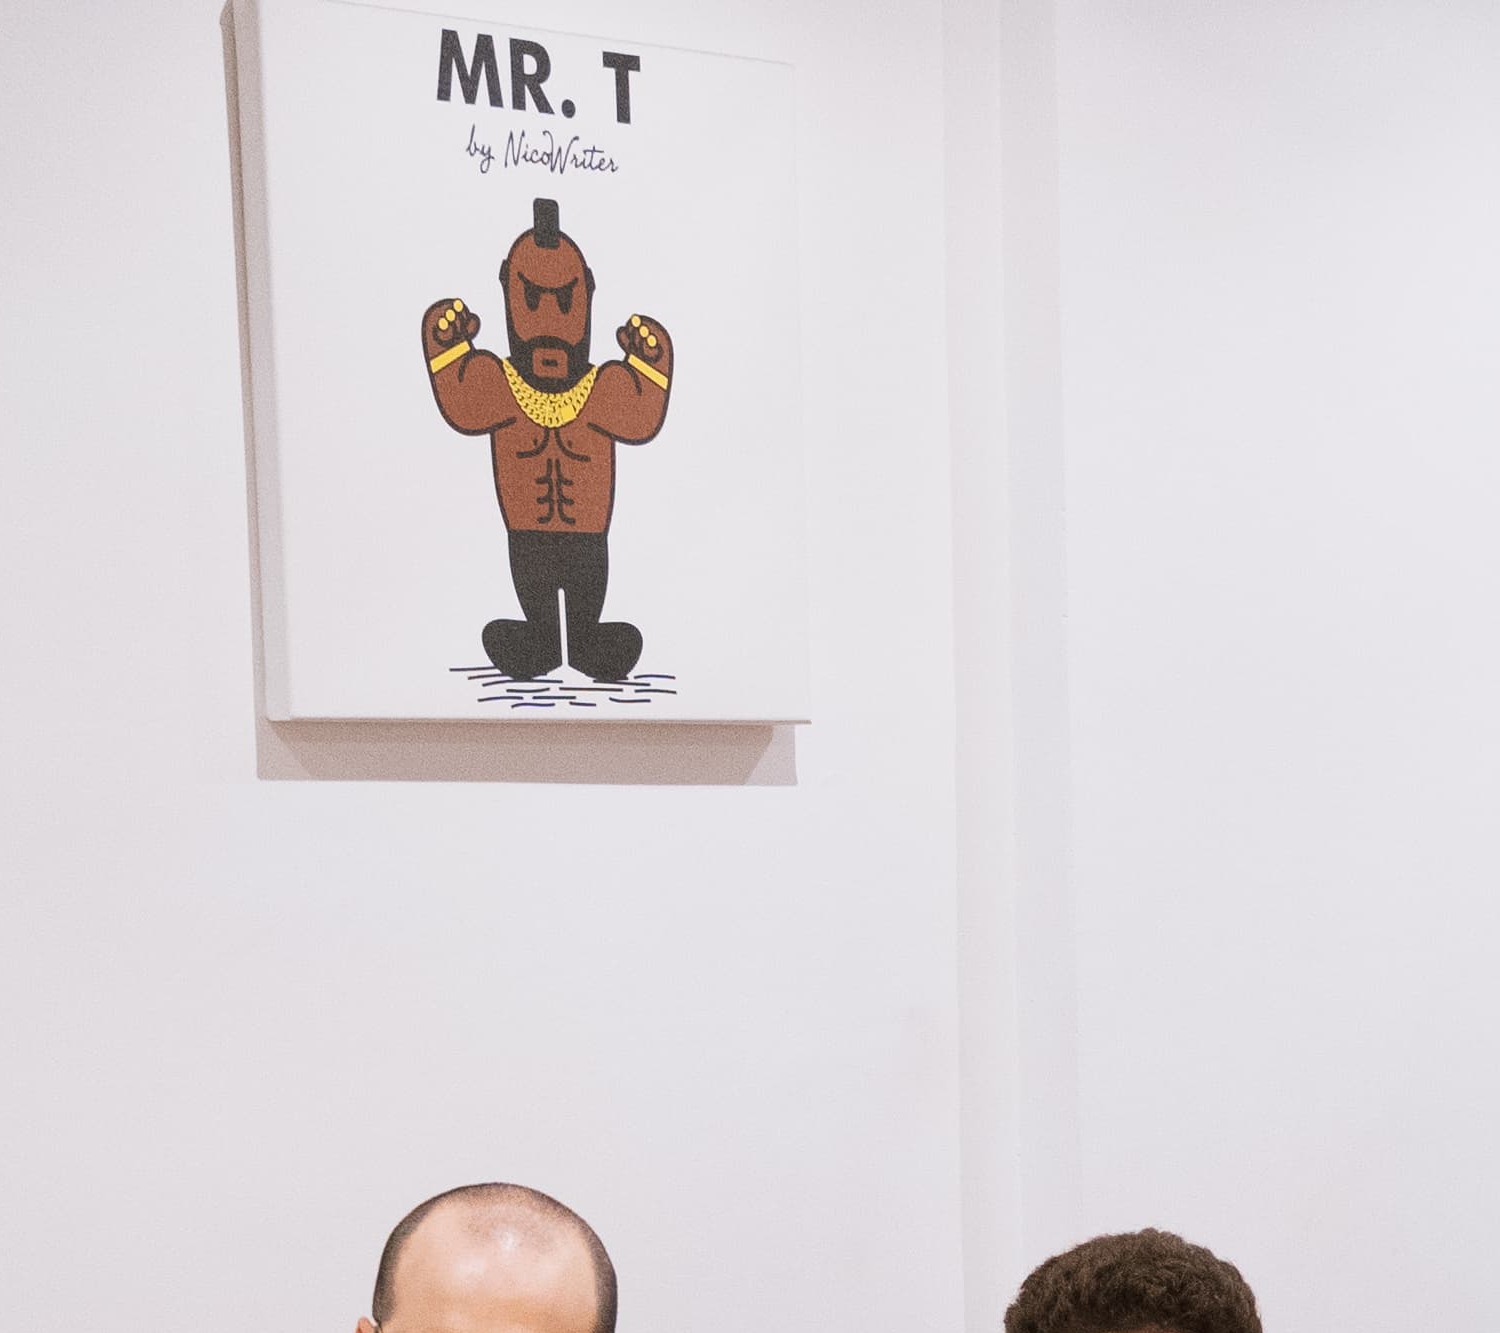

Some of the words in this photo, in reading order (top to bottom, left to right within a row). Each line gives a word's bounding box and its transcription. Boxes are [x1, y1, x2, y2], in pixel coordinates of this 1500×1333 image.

[436, 28, 576, 119] MR.
[602, 50, 641, 125] T
[466, 123, 496, 174] by
[504, 130, 619, 175] NicoWriter
